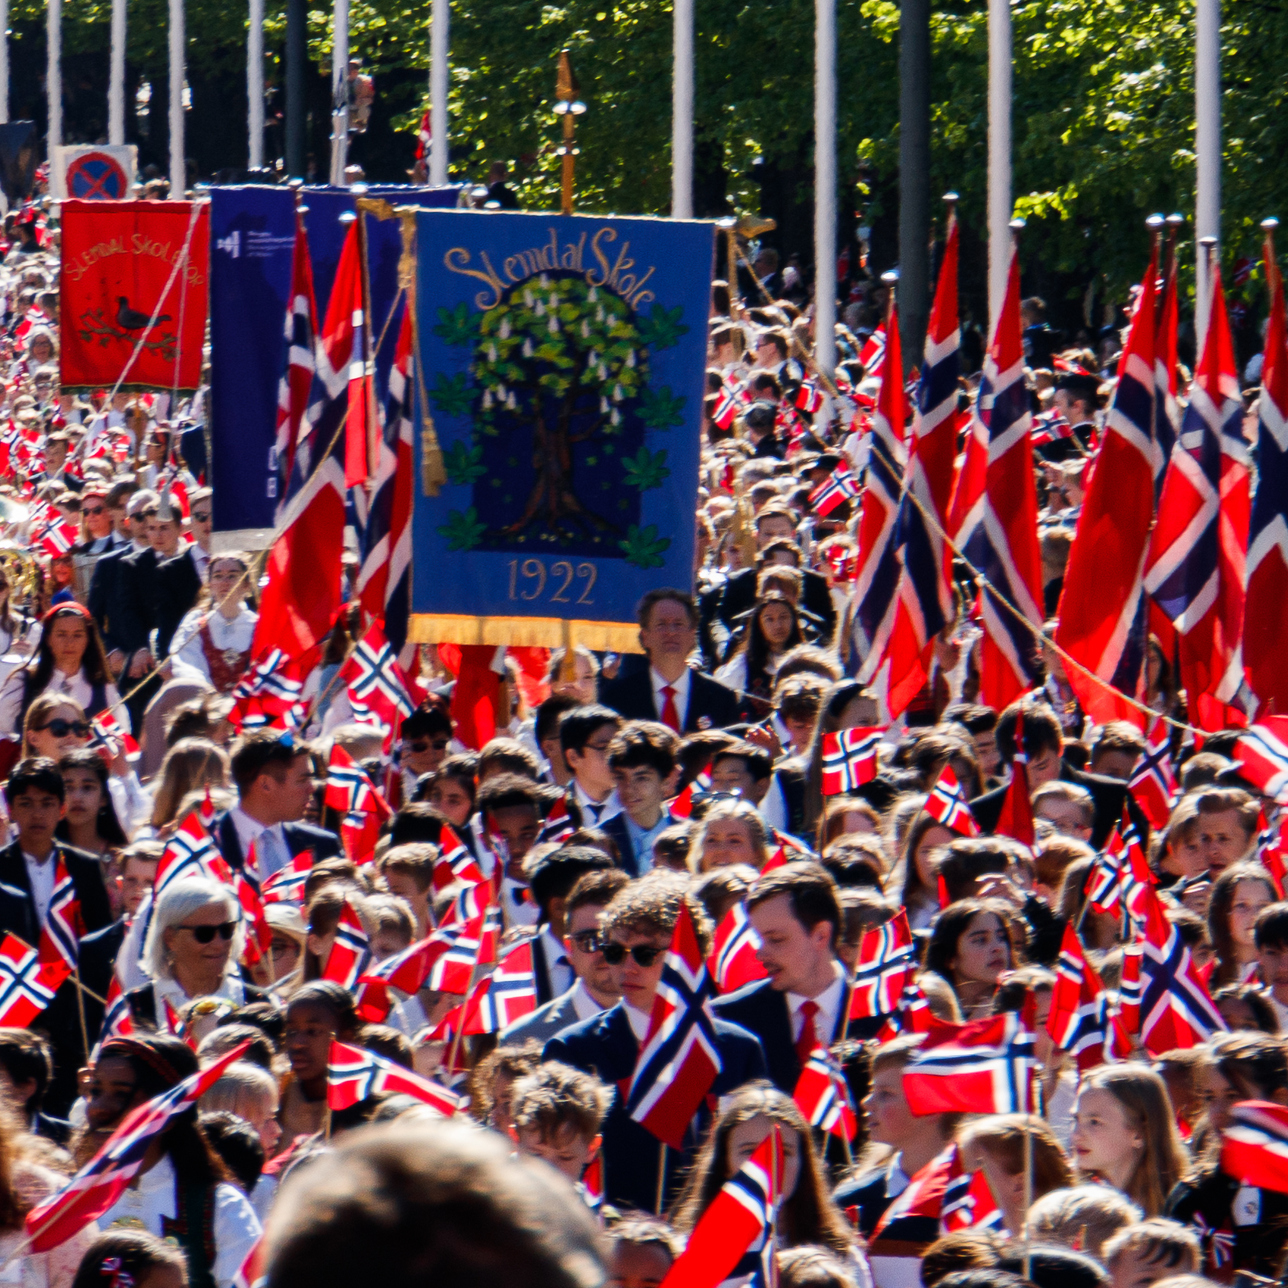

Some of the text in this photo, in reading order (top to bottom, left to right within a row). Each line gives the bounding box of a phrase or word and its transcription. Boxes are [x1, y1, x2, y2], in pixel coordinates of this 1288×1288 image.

[443, 227, 656, 311] Slemdal Skole
[508, 559, 597, 605] 1922
